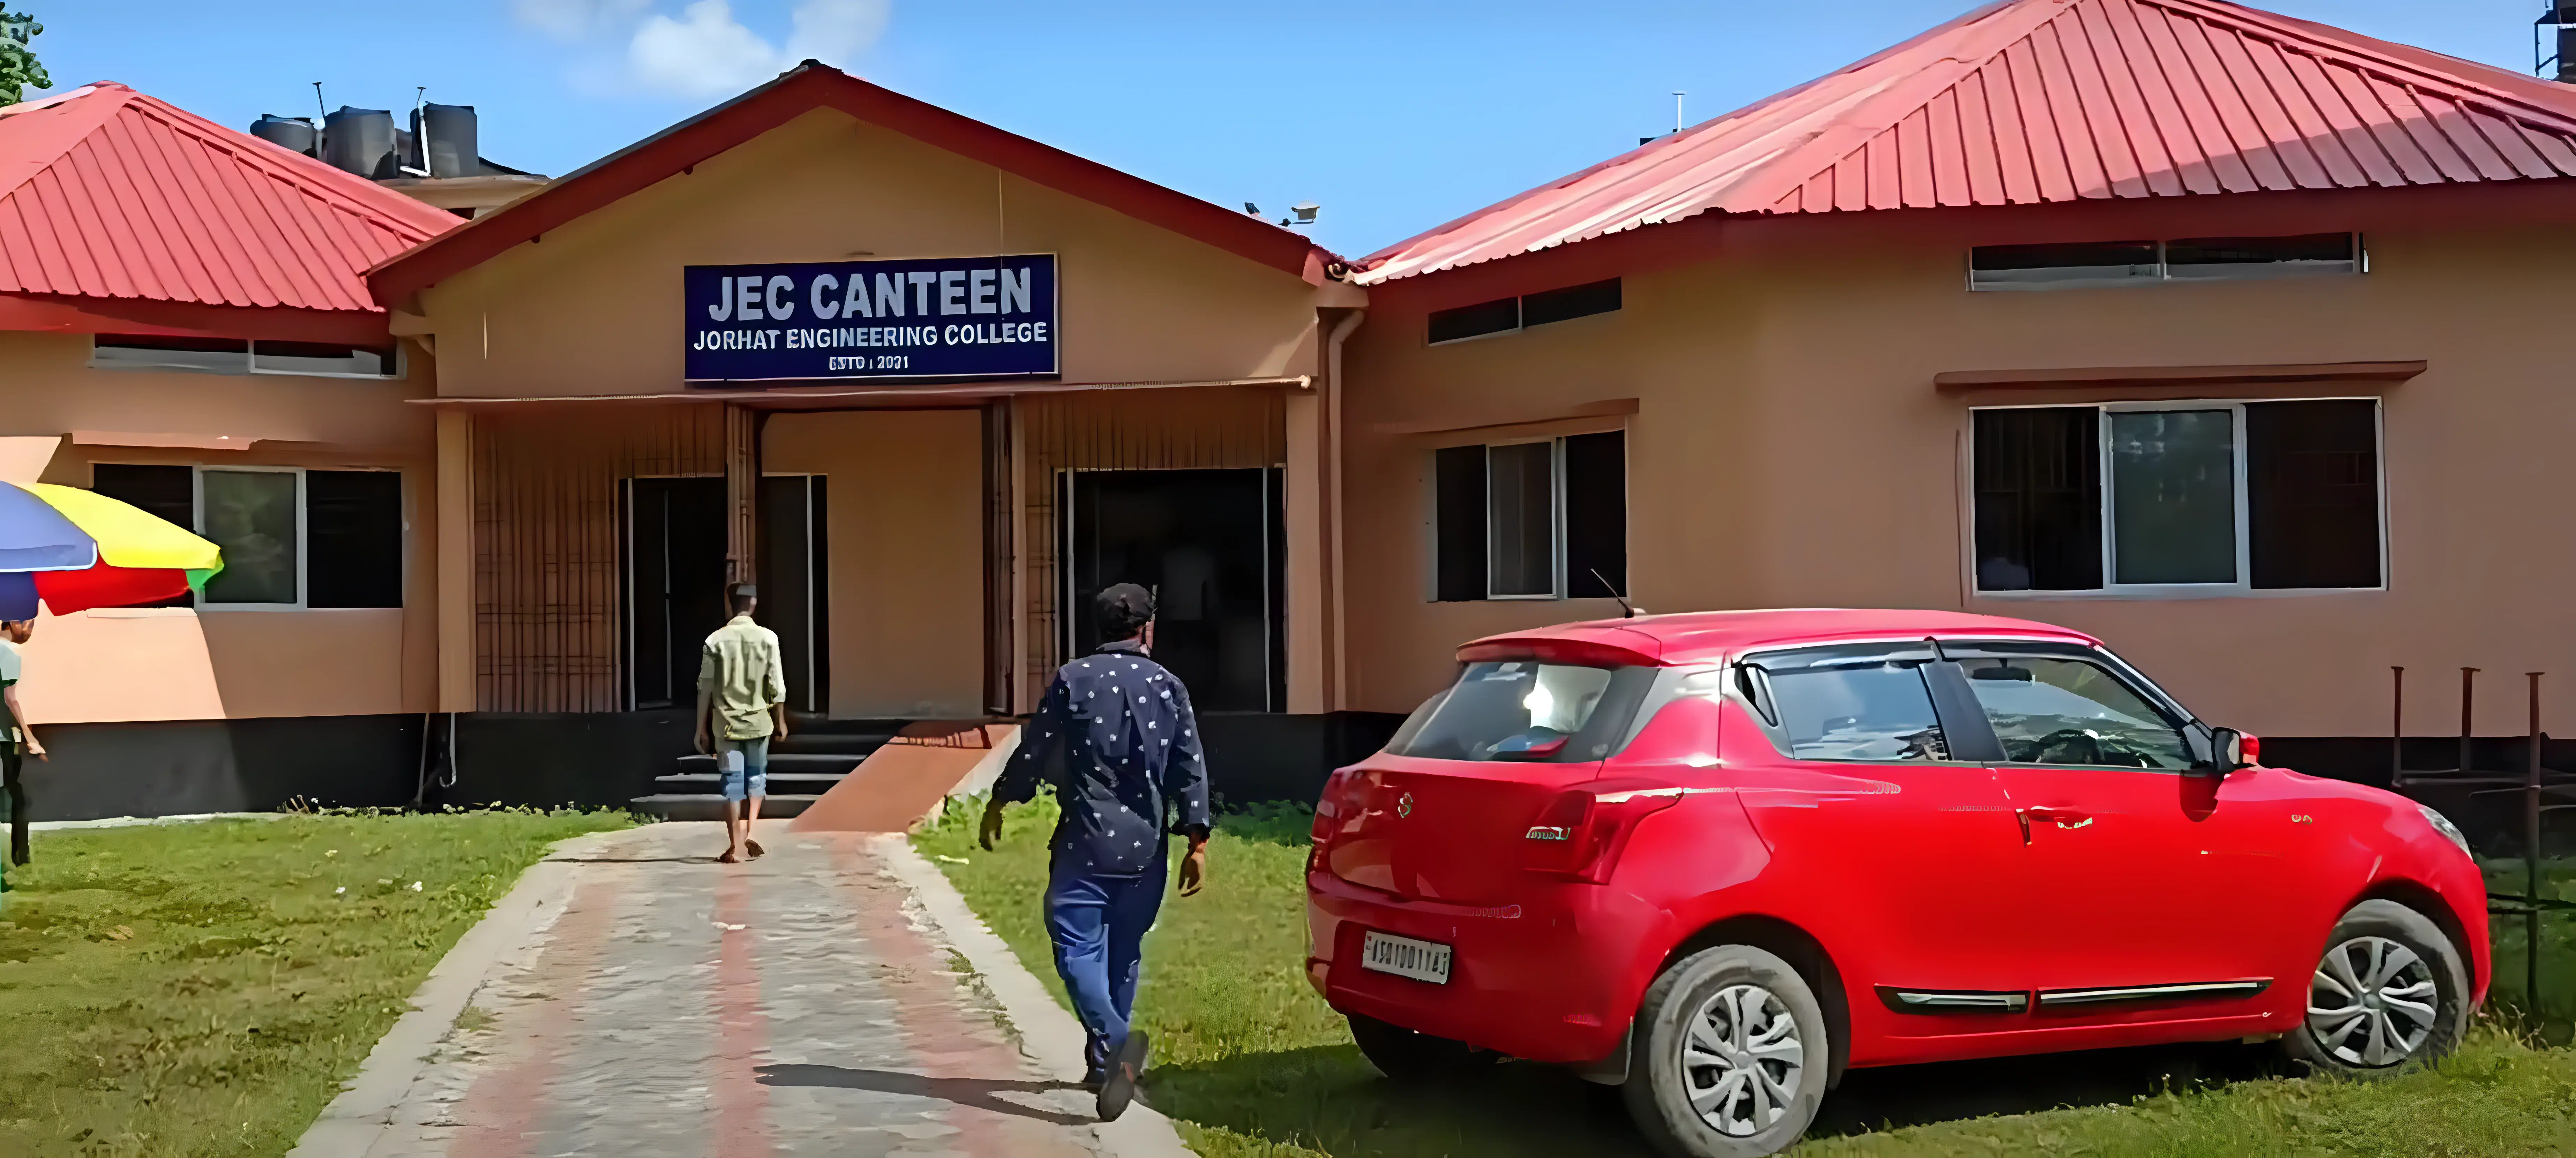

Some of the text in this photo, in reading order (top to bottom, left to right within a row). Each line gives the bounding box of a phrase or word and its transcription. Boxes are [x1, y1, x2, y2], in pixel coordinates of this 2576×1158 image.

[709, 268, 1031, 322] JEC CANTEEN
[694, 322, 1047, 350] JORHAT ENGINEERING COLLEGE
